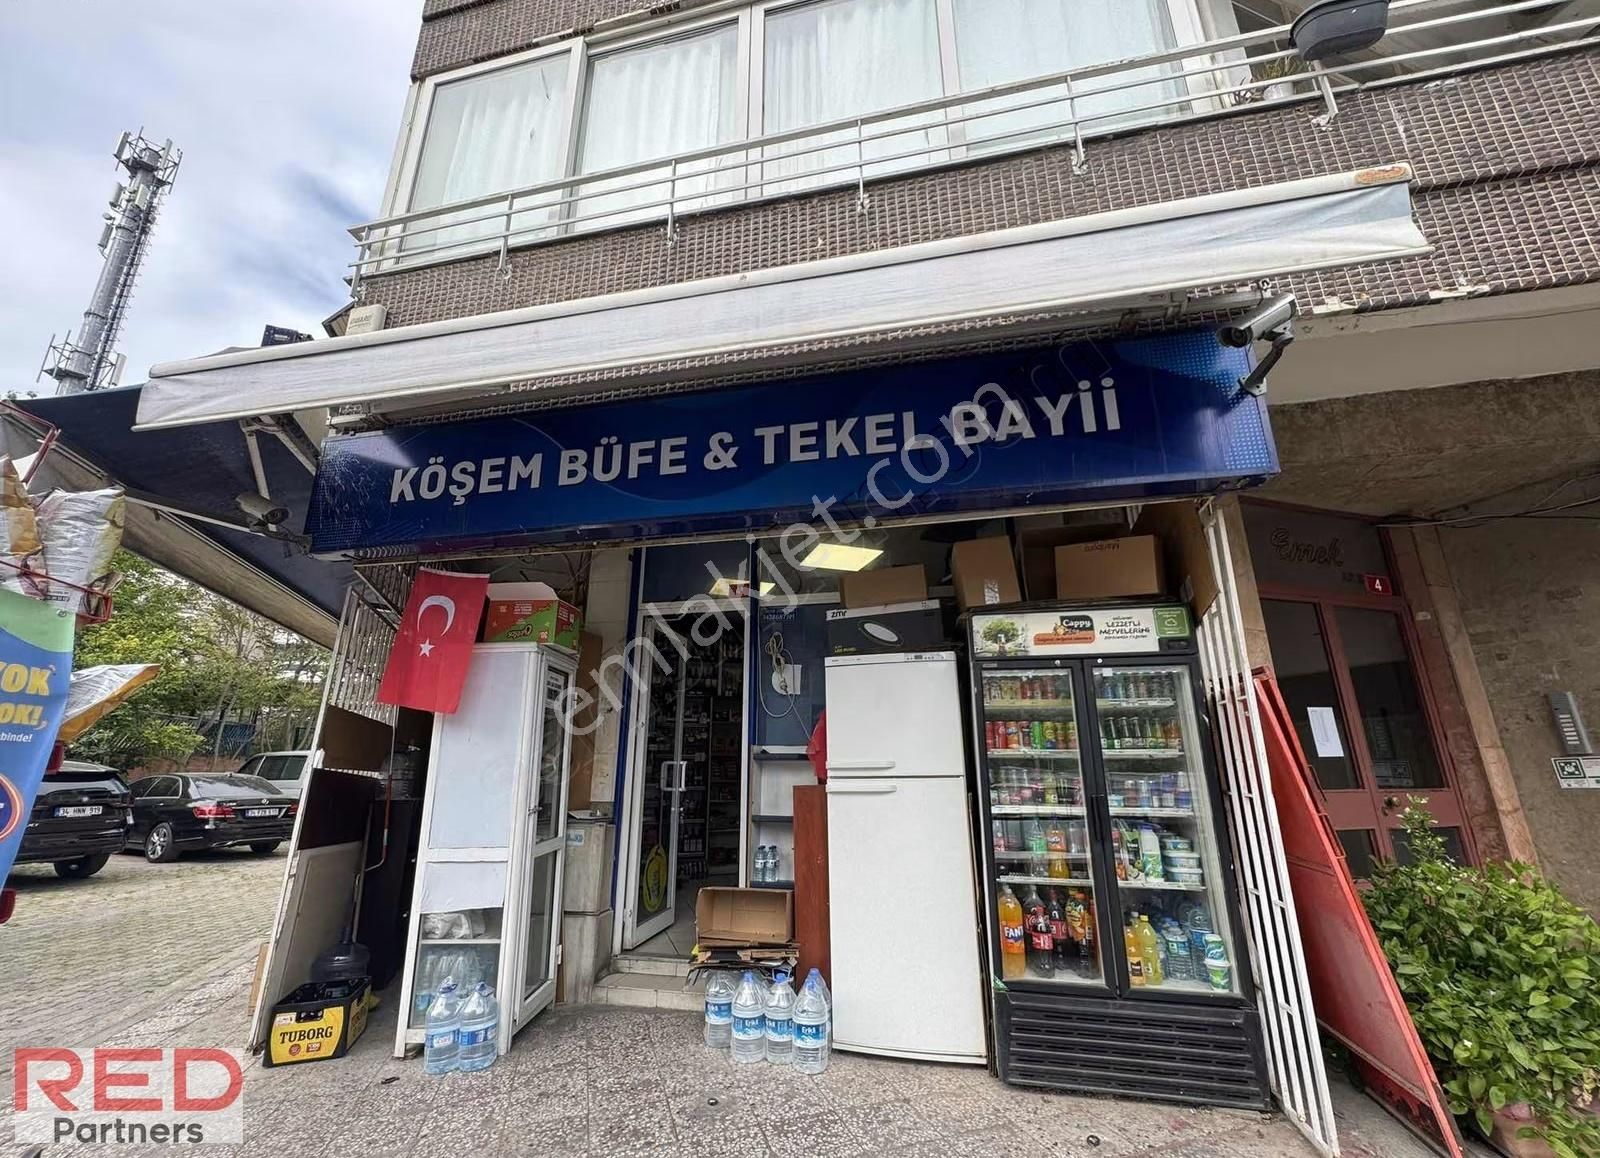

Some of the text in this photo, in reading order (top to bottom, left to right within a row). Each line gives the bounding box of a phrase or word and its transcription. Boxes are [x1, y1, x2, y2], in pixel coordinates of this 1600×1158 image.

[389, 453, 543, 507] KÖŞEM
[558, 435, 688, 487] BÜFE
[703, 431, 739, 471] &
[754, 411, 934, 465] TEKEL
[1271, 527, 1344, 567] Emek
[1374, 578, 1382, 592] 4
[1062, 618, 1092, 628] Cappy
[0, 662, 51, 696] OK
[280, 1025, 334, 1044] TUBORG
